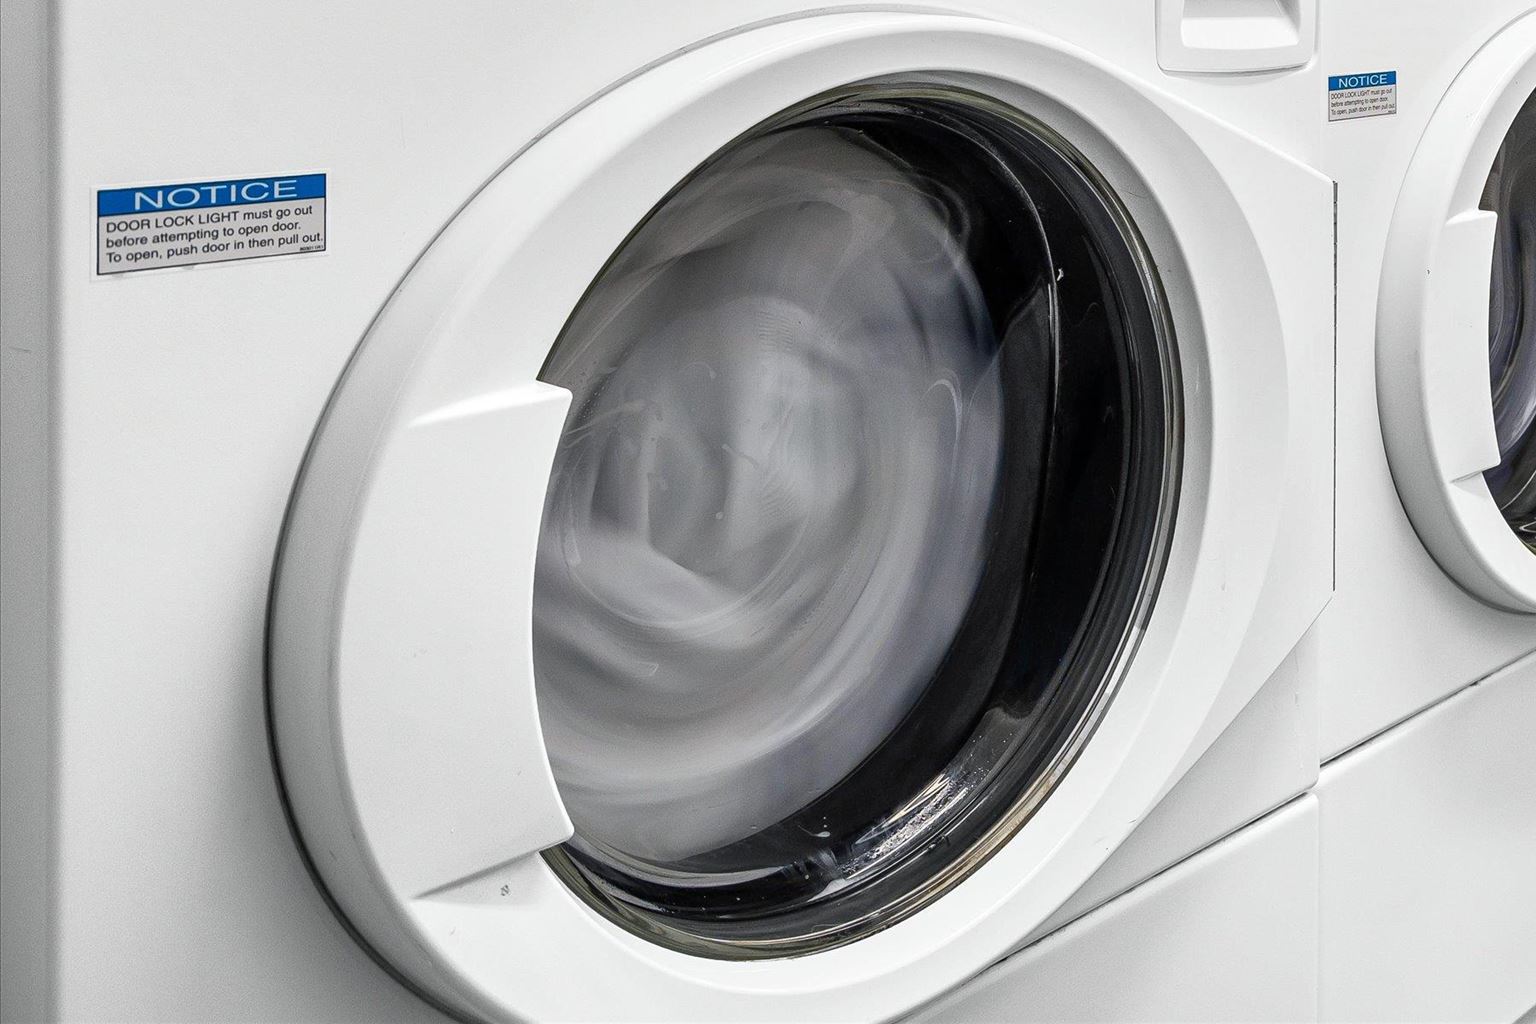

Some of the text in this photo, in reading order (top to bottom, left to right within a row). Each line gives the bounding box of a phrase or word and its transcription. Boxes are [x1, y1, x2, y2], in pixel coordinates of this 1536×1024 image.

[1339, 74, 1387, 88] NOTICE
[134, 179, 298, 210] NOTICE
[106, 205, 313, 233] DOOR LOCK LIGHT must go out
[106, 220, 301, 249] before attempting to open door.
[106, 232, 323, 263] To open, push door in then pull out.
